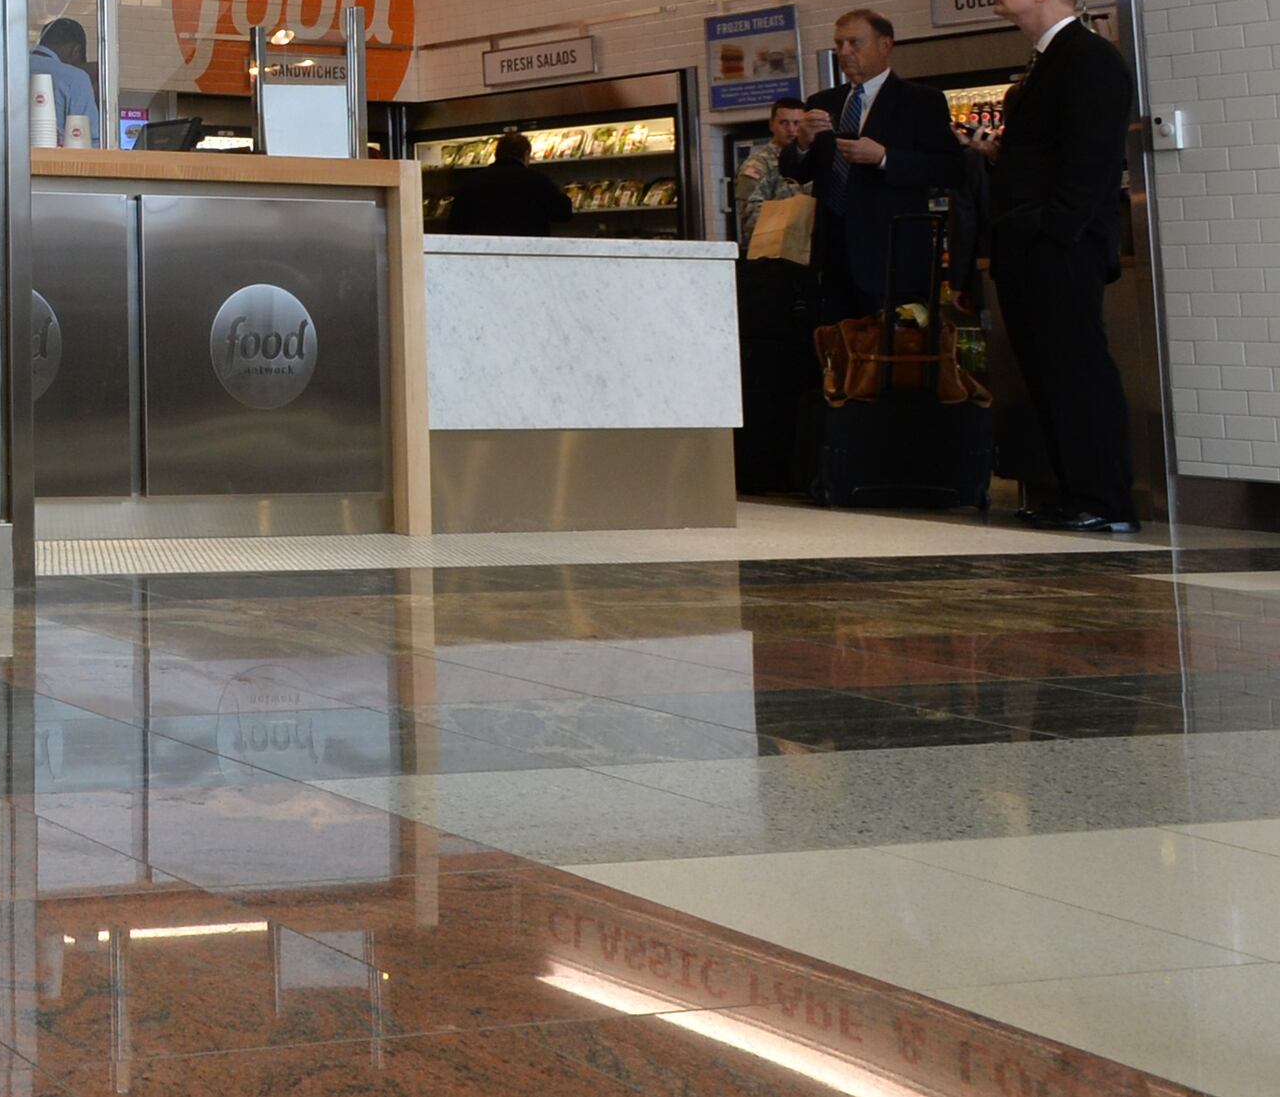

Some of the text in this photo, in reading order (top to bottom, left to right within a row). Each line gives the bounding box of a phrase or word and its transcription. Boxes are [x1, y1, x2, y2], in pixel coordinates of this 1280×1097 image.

[716, 14, 785, 35] FROZEN TREATS
[270, 63, 347, 81] SANDWICHES
[500, 49, 577, 73] FRESH SALADS
[224, 315, 310, 378] food
